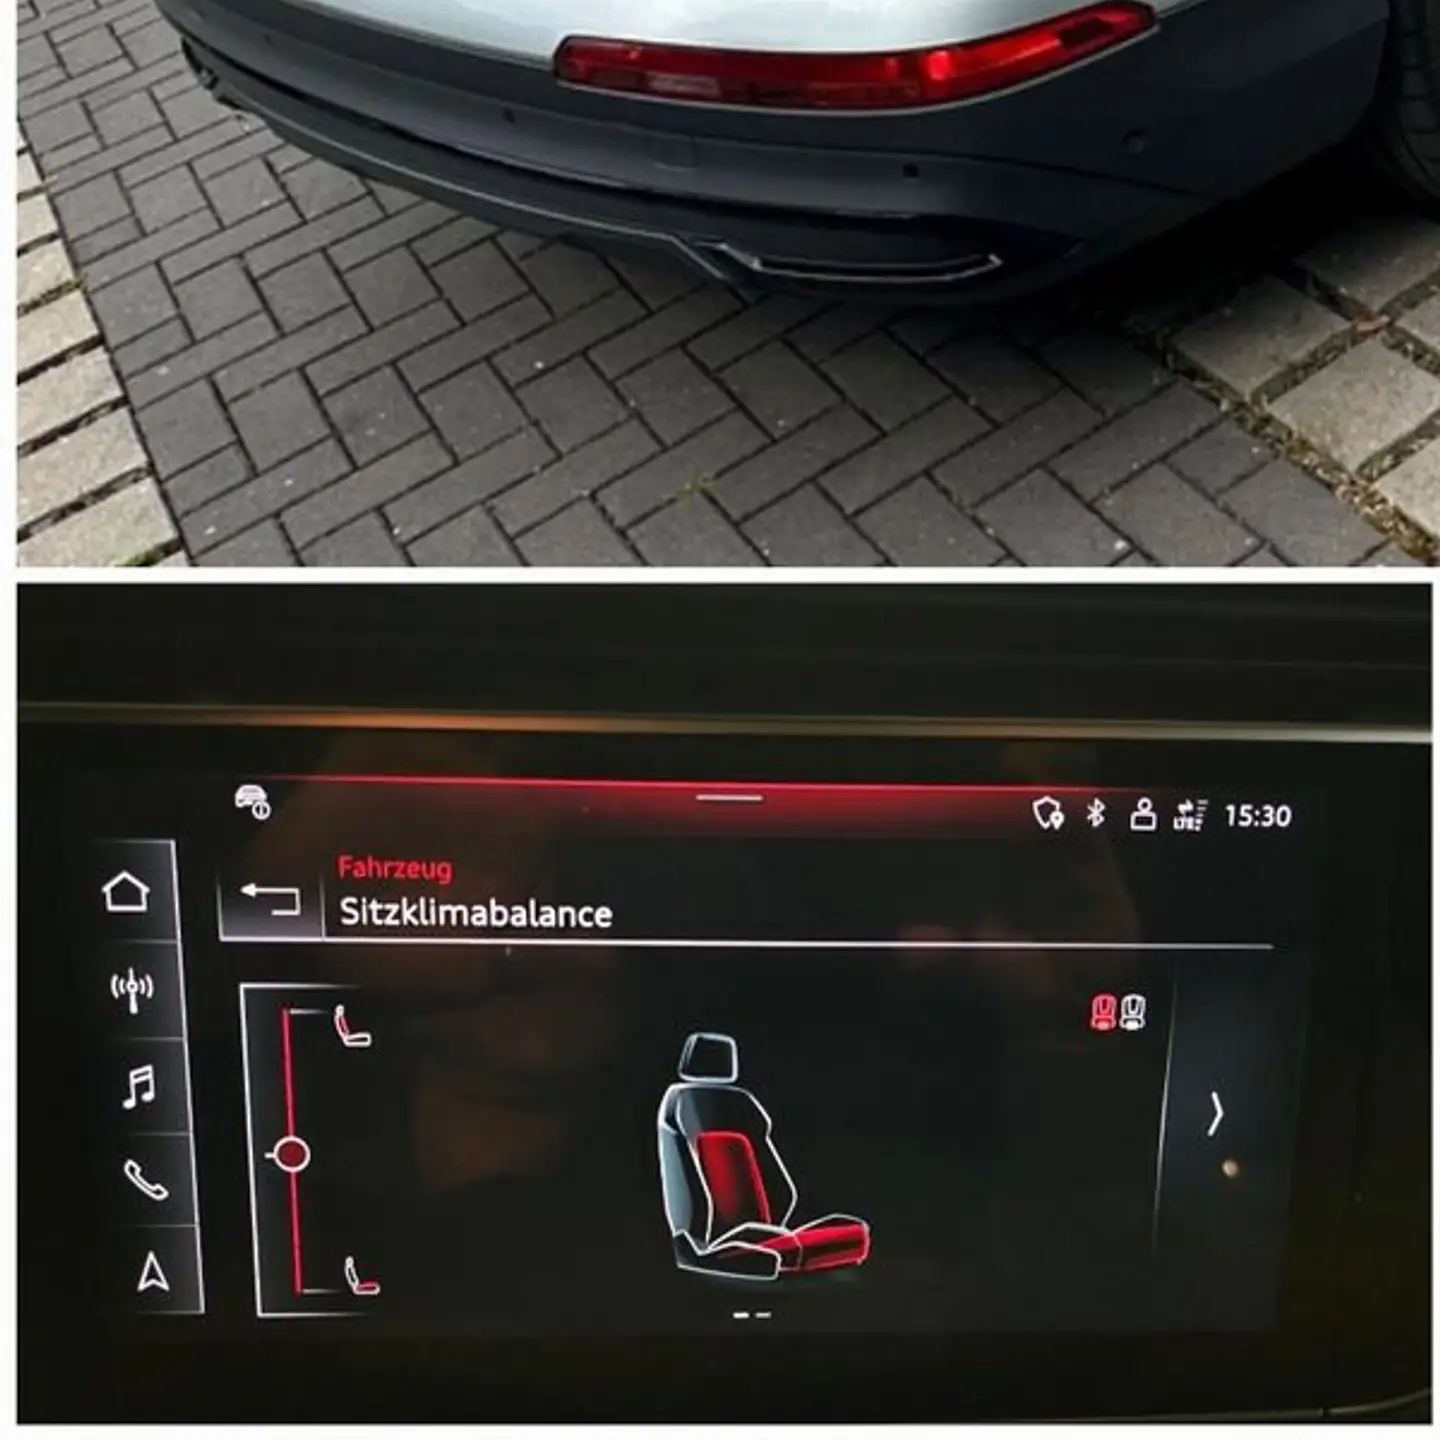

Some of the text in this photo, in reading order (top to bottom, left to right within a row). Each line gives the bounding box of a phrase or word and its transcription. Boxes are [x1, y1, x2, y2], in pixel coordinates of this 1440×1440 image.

[1225, 803, 1293, 828] 15:30
[337, 855, 454, 885] Fahrzeug
[339, 896, 614, 929] Sitzklimabalance
